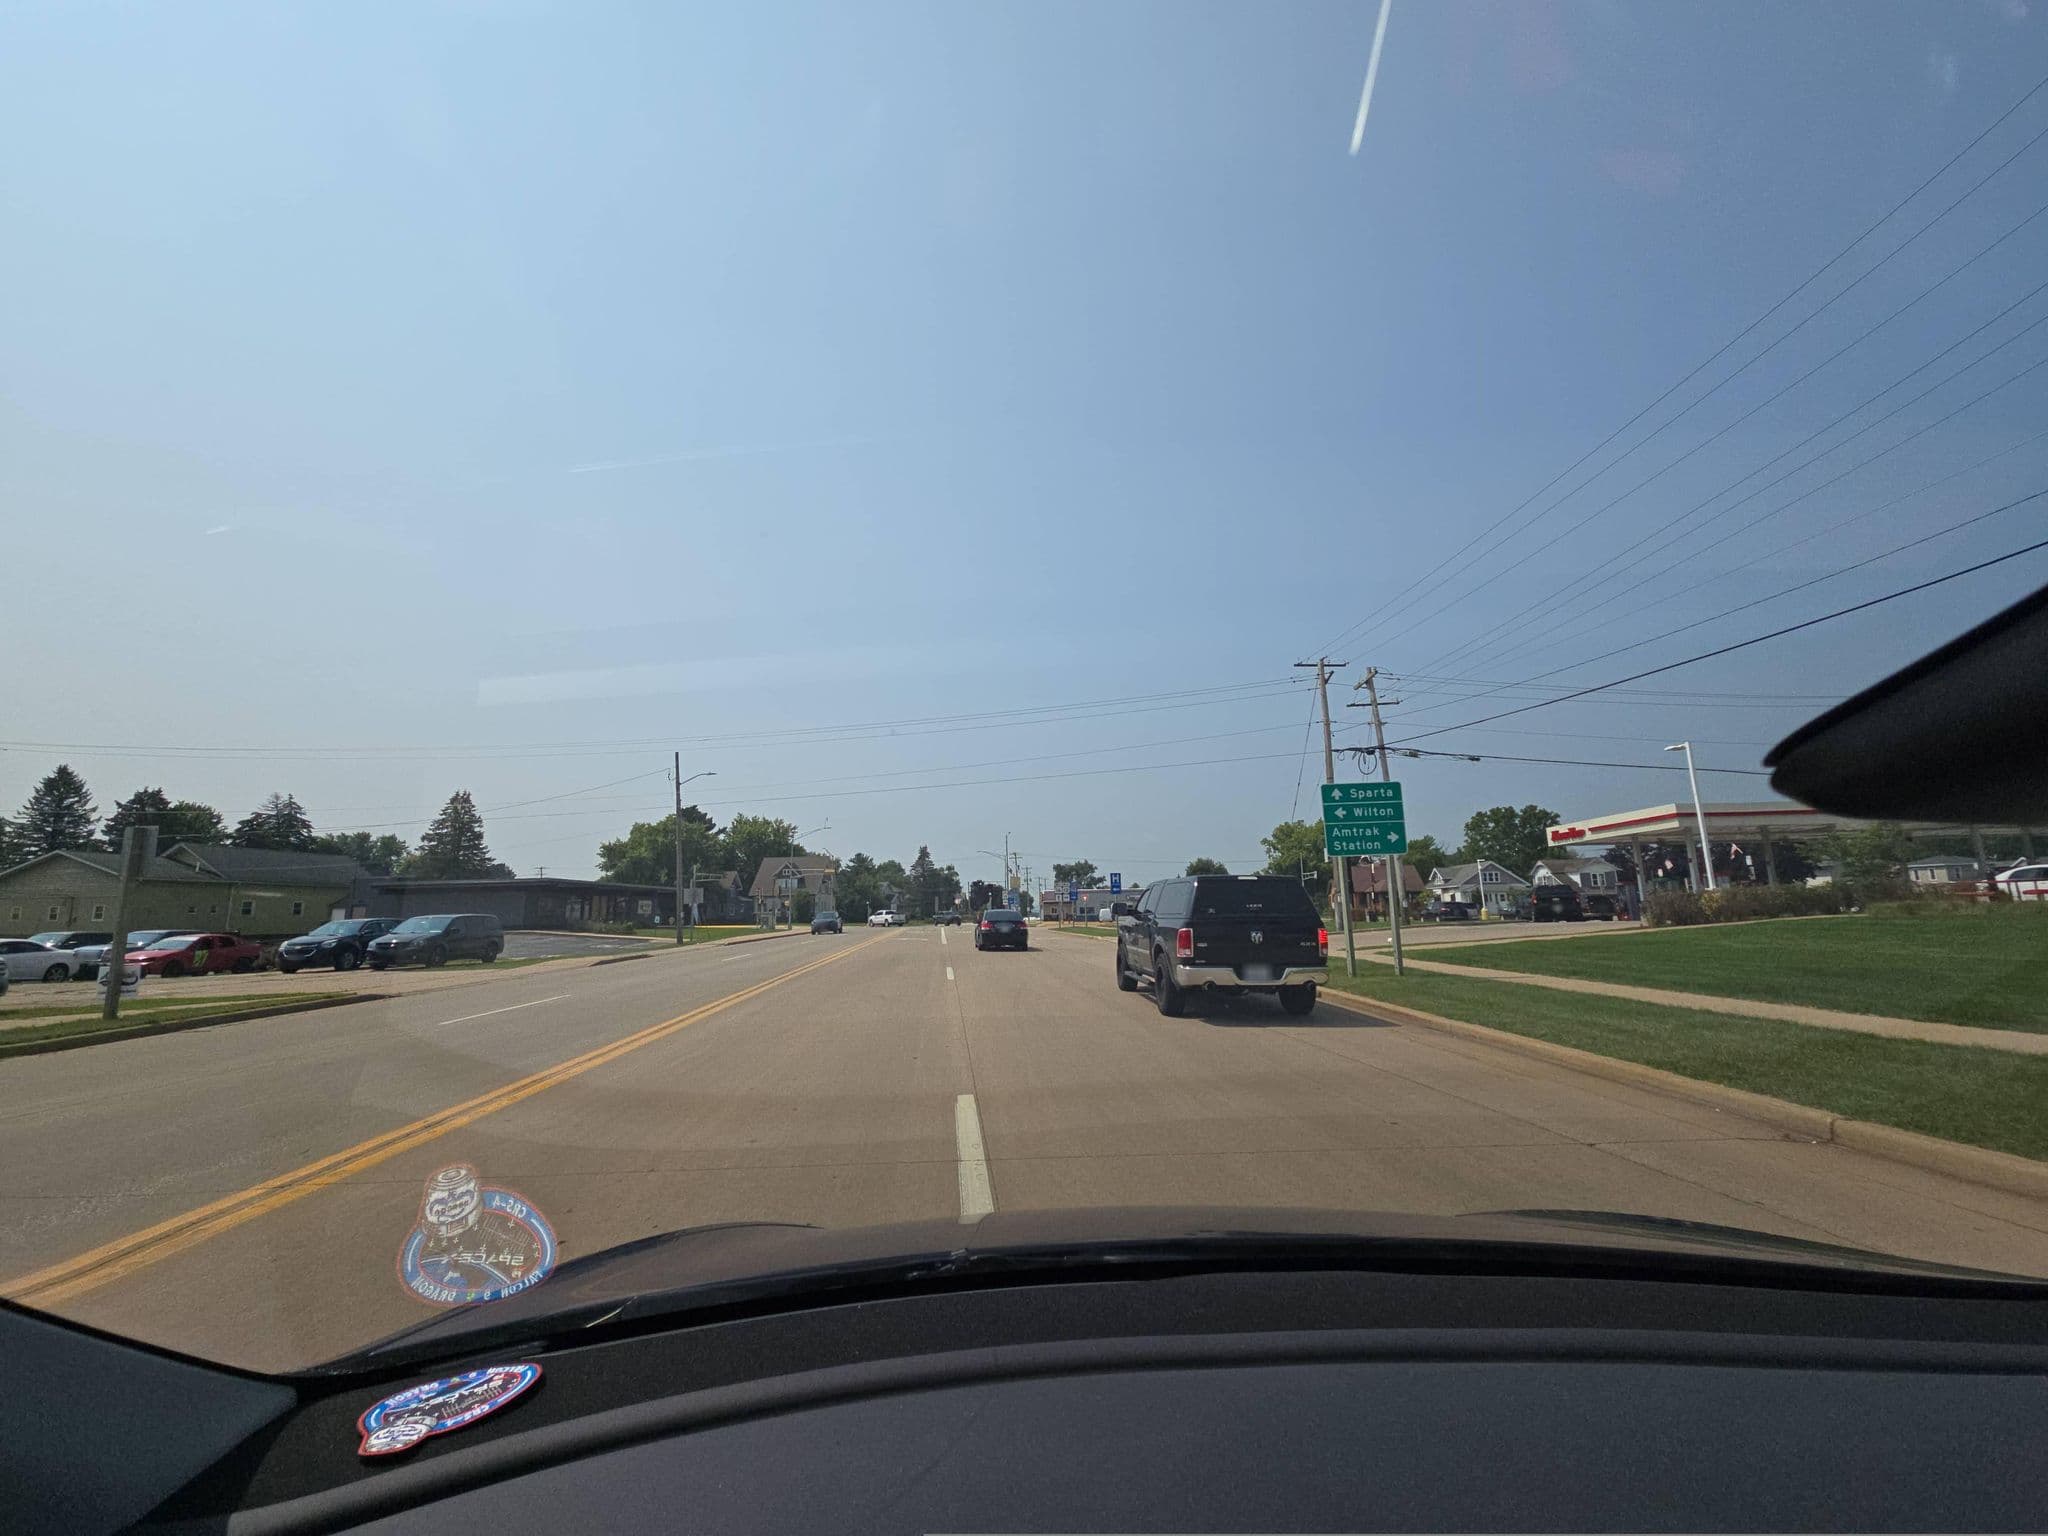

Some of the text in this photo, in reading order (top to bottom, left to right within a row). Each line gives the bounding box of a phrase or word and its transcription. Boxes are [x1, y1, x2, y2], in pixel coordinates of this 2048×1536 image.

[1350, 787, 1393, 800] Sparta
[1353, 807, 1394, 817] Wilton
[1332, 826, 1380, 837] Amtrak
[1333, 840, 1381, 851] Station
